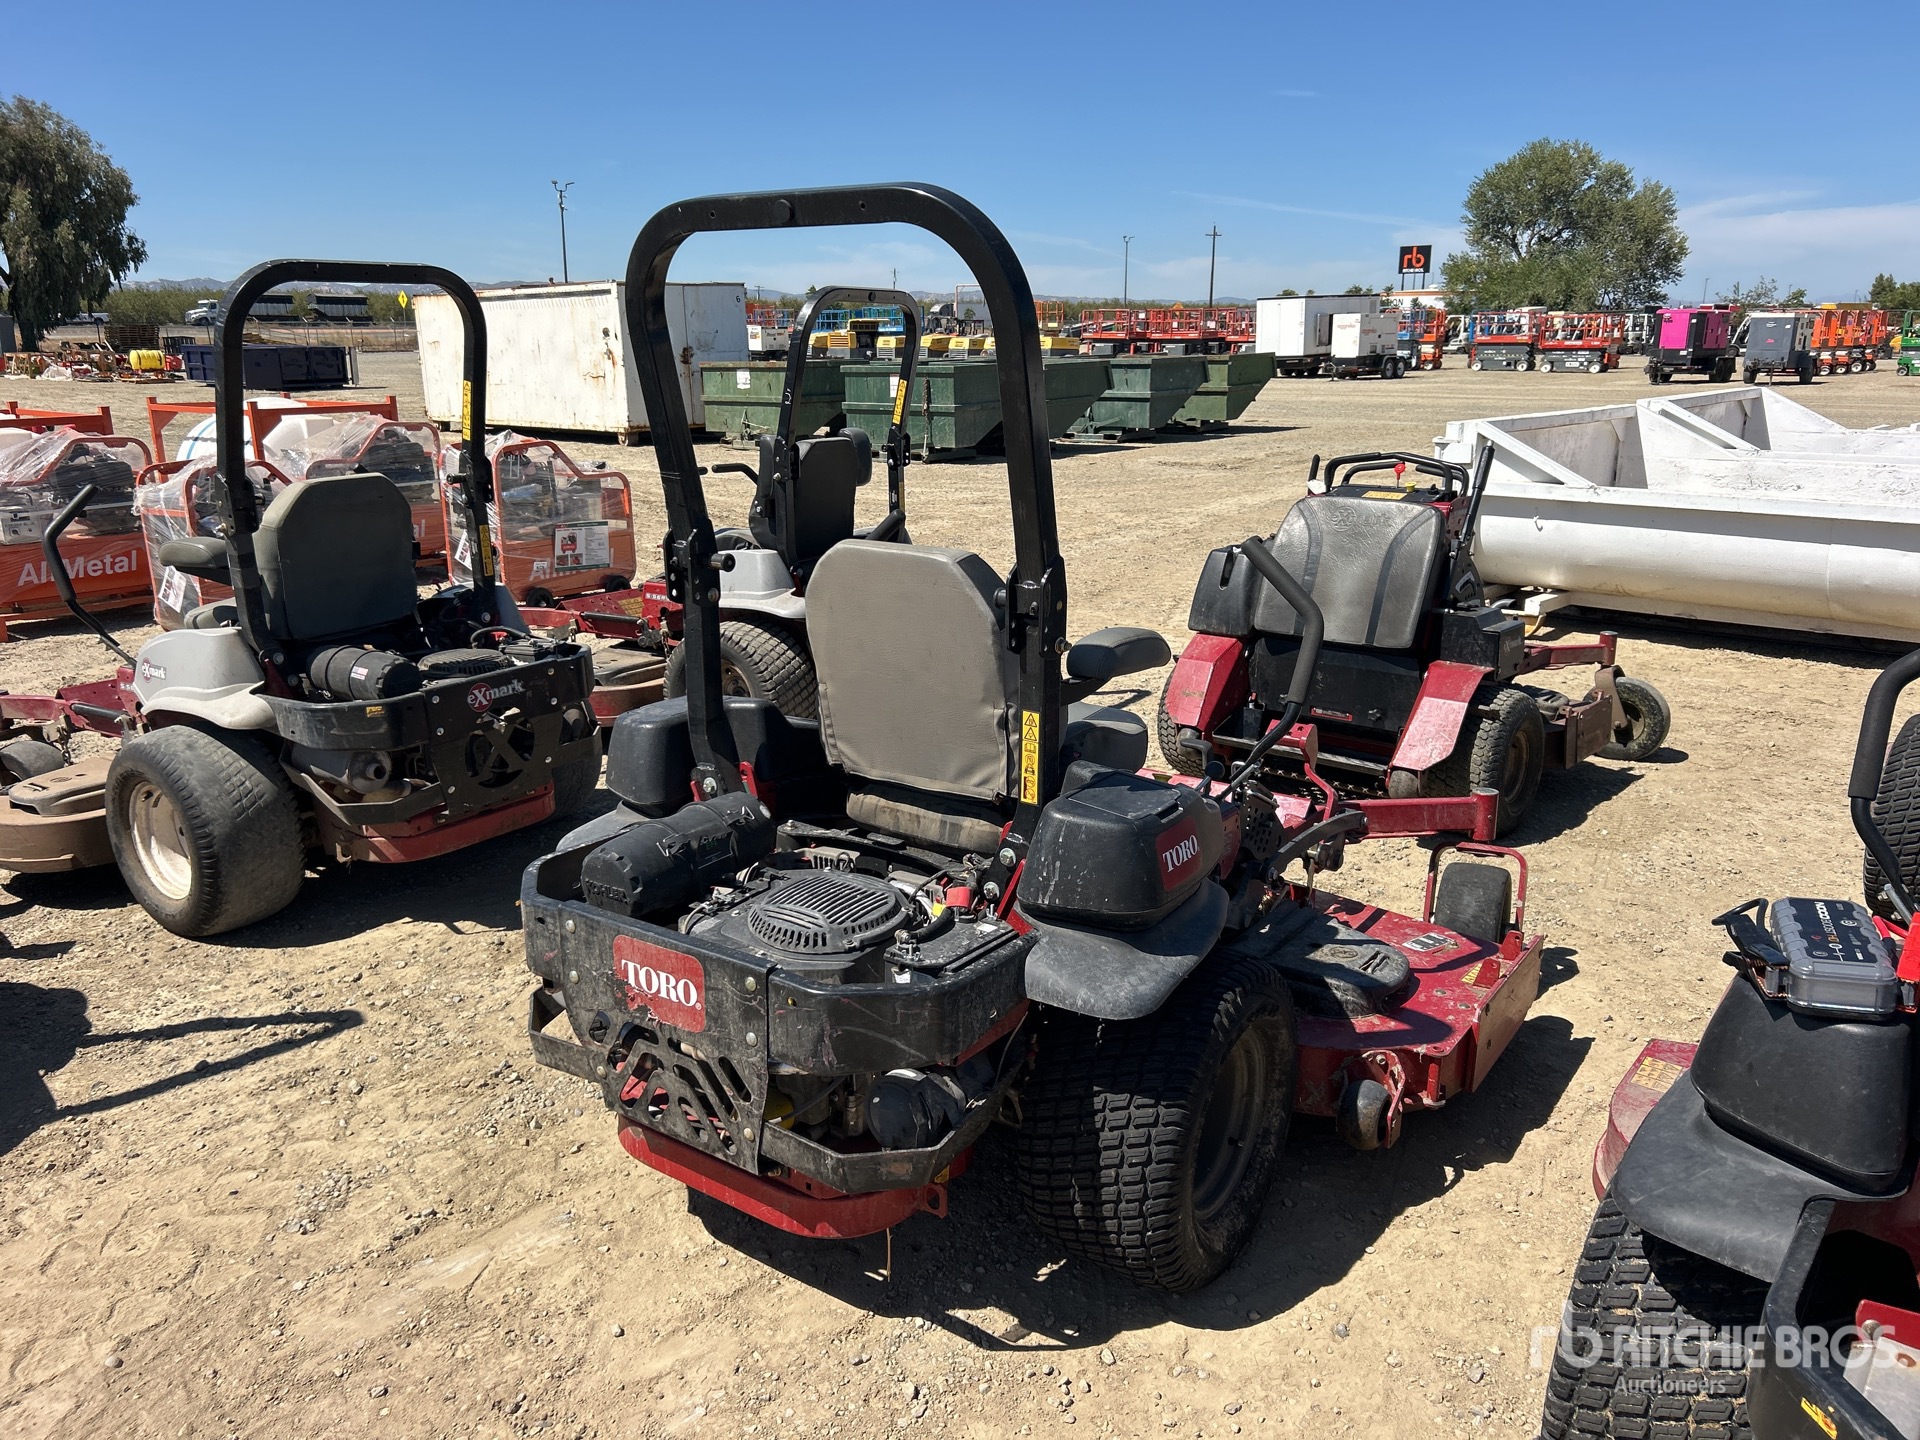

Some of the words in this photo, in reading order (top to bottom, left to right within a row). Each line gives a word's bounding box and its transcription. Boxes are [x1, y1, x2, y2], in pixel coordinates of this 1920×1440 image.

[1403, 247, 1425, 268] rb
[466, 678, 527, 709] eXmark
[1162, 834, 1199, 874] TORO
[585, 878, 630, 905] KOHLER
[621, 958, 698, 1008] TORO
